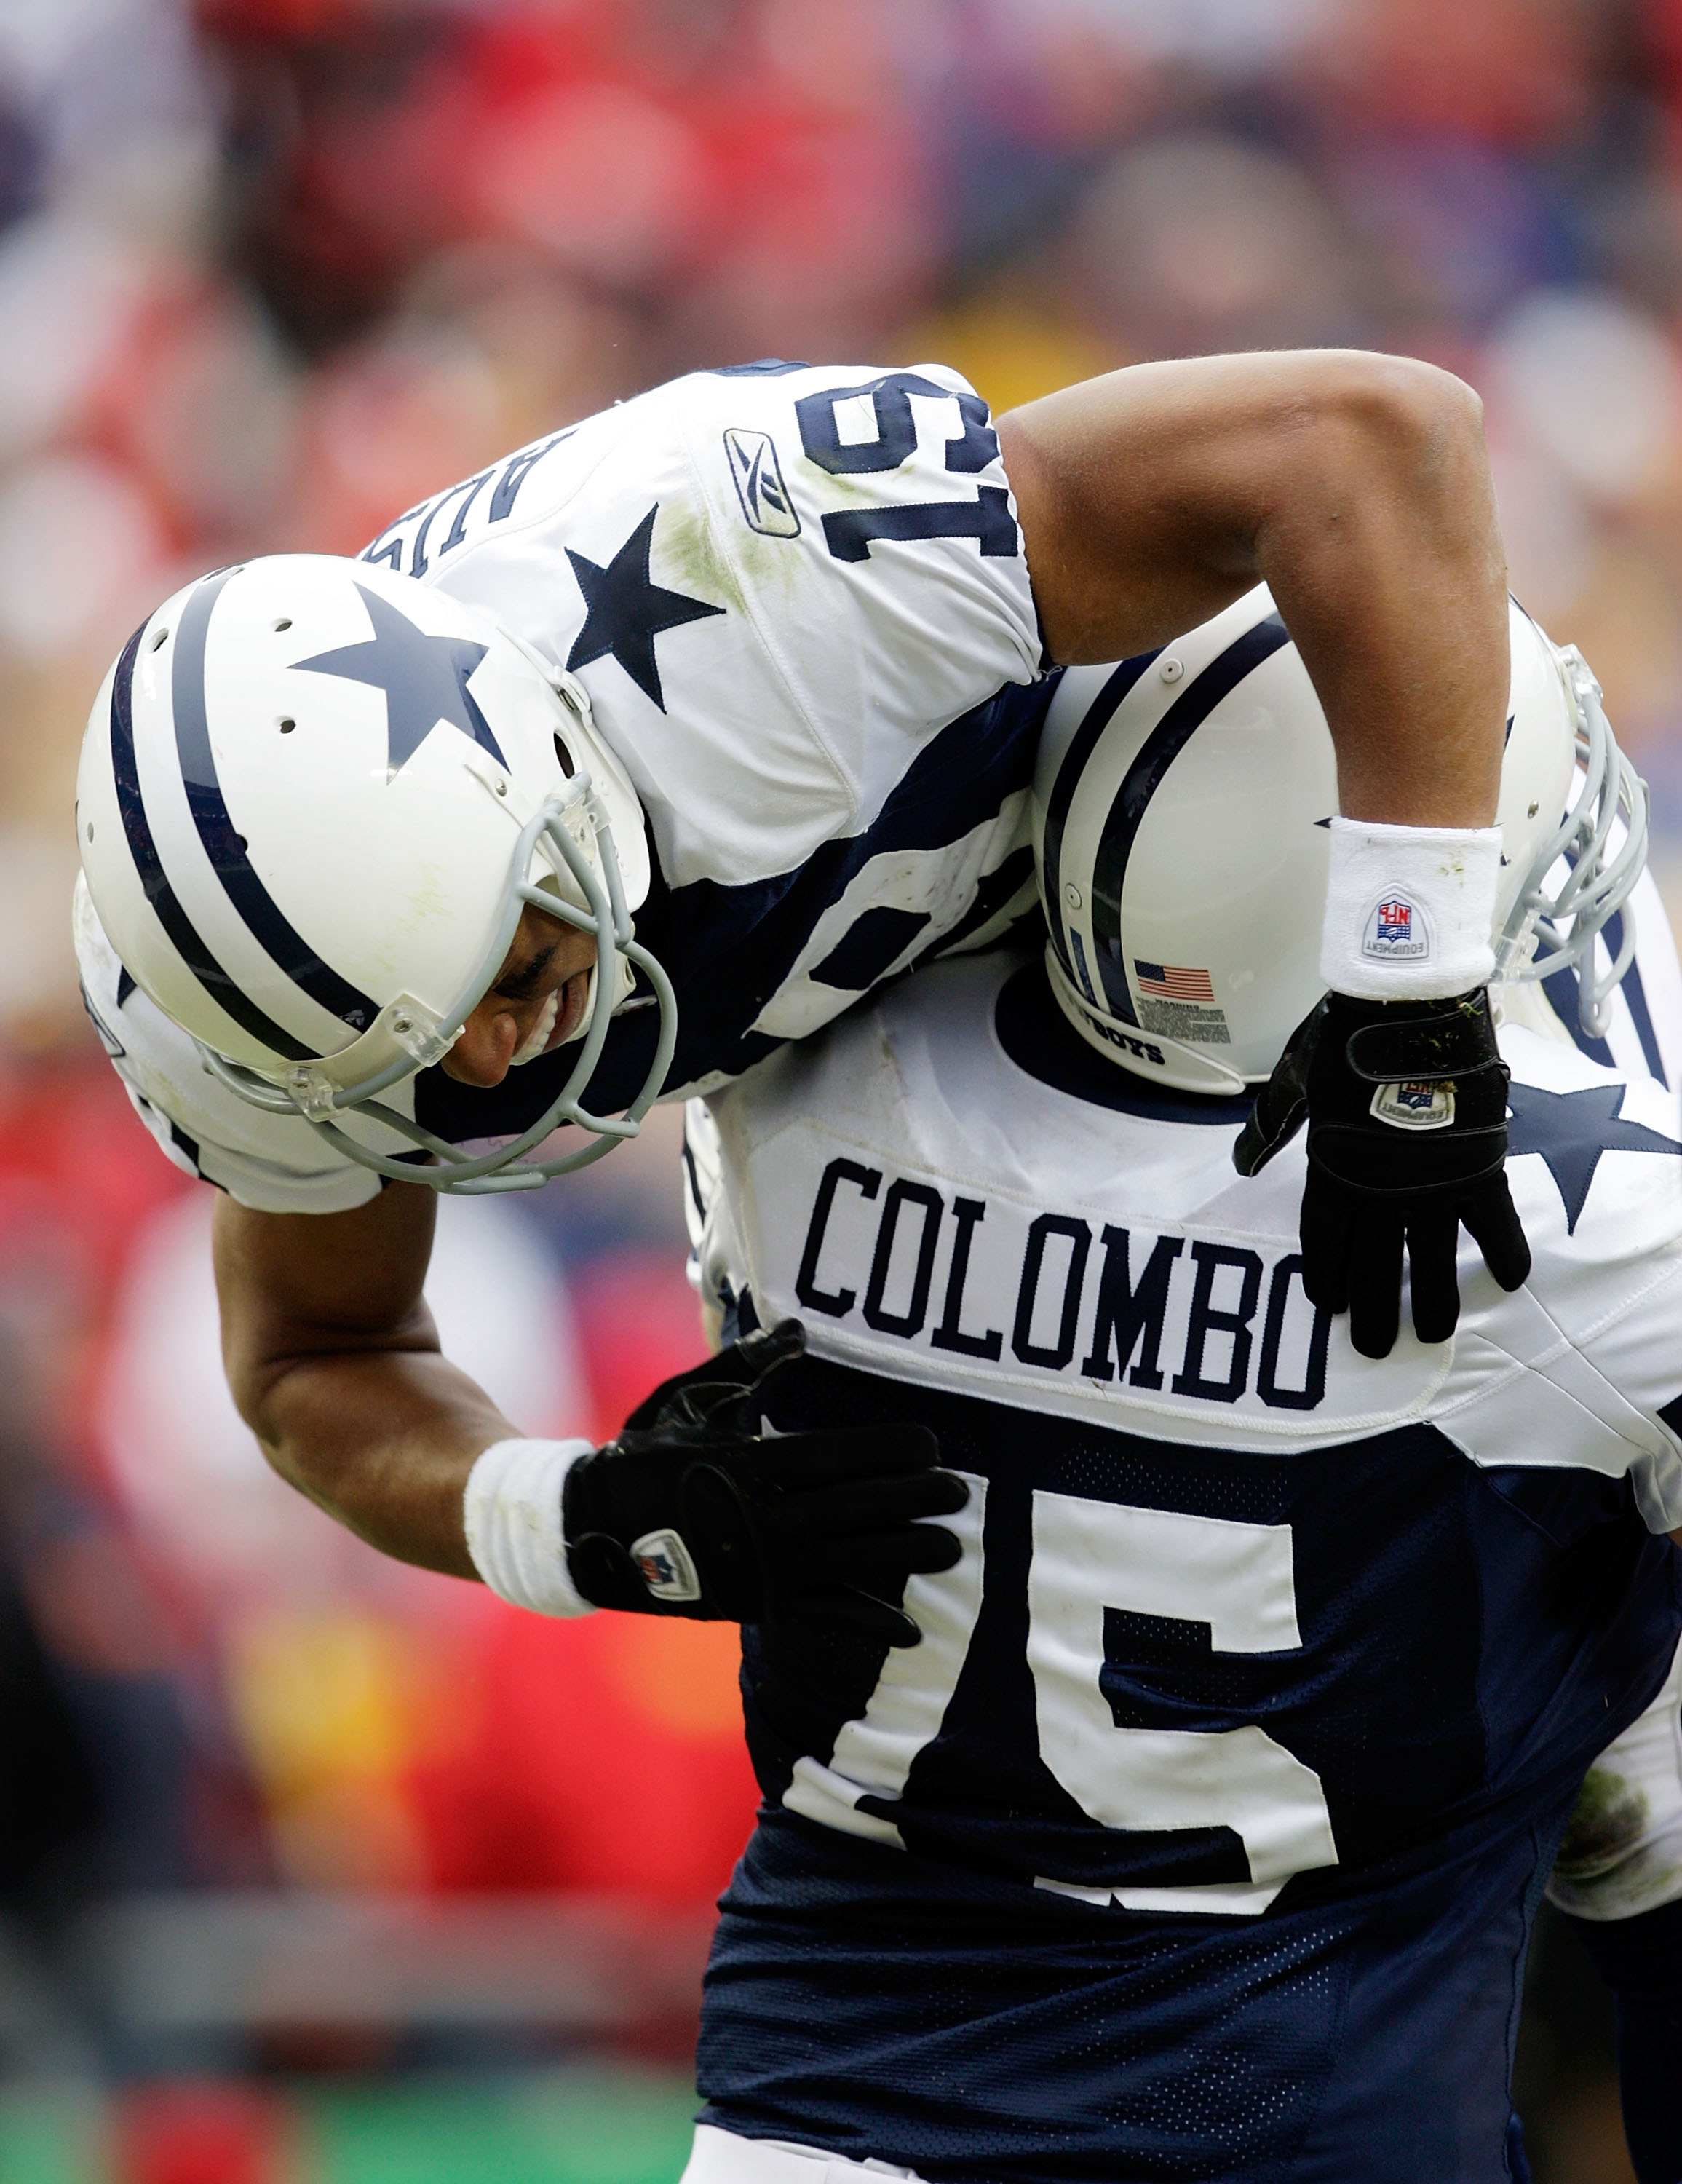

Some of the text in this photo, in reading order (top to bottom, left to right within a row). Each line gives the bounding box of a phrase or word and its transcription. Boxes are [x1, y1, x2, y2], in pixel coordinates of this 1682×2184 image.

[795, 373, 1019, 563] 19
[1380, 904, 1411, 924] NFL
[796, 1158, 1333, 1410] COLOMBO
[782, 1465, 1339, 1915] 75
